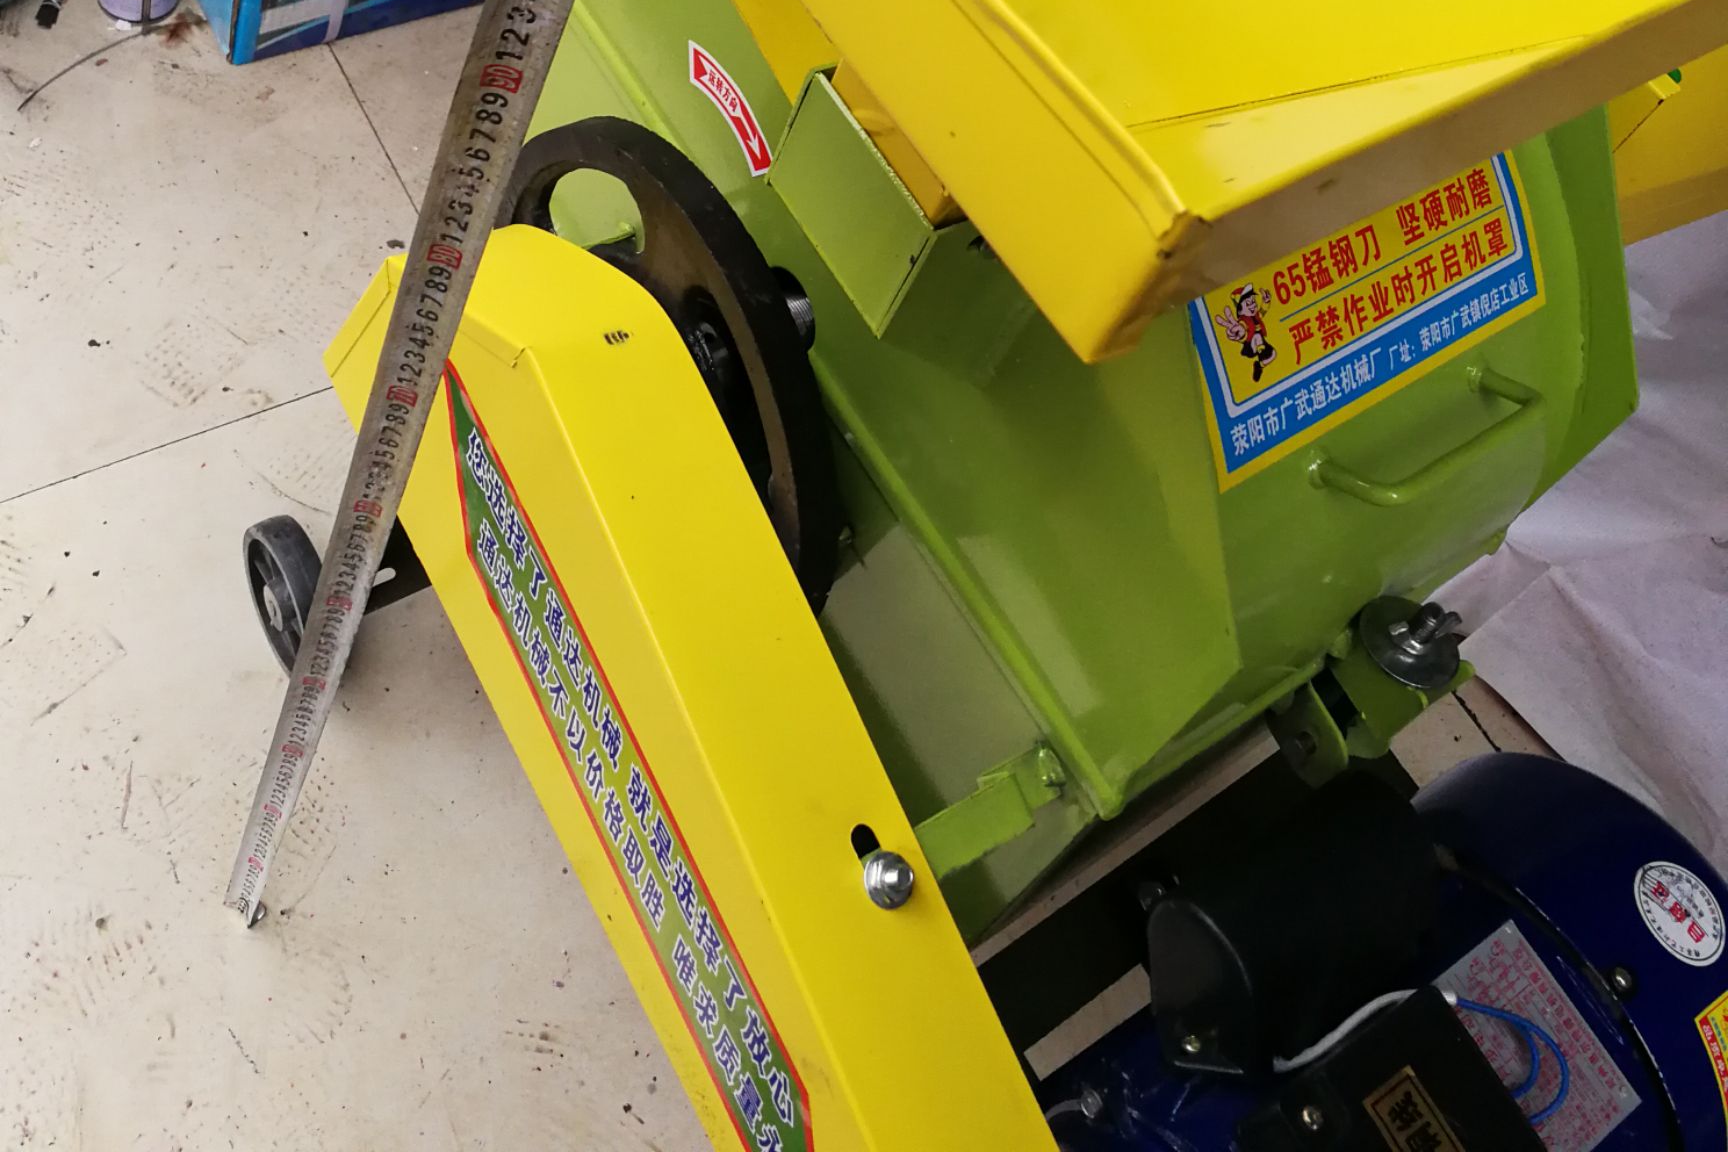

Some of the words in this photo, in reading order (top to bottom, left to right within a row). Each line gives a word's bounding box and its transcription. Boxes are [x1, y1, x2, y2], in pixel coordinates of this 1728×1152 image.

[1272, 223, 1383, 306] 65锰钢刀
[1396, 168, 1494, 247] 坚硬耐磨
[1288, 217, 1509, 366] 严禁作业时开启机罩
[1230, 346, 1383, 457] 荥阳市广武通达机械厂
[466, 426, 623, 770] 您选择了通达机械
[627, 765, 795, 1128] 就是选择了放心
[476, 517, 666, 933] 通达机械不以价格取胜
